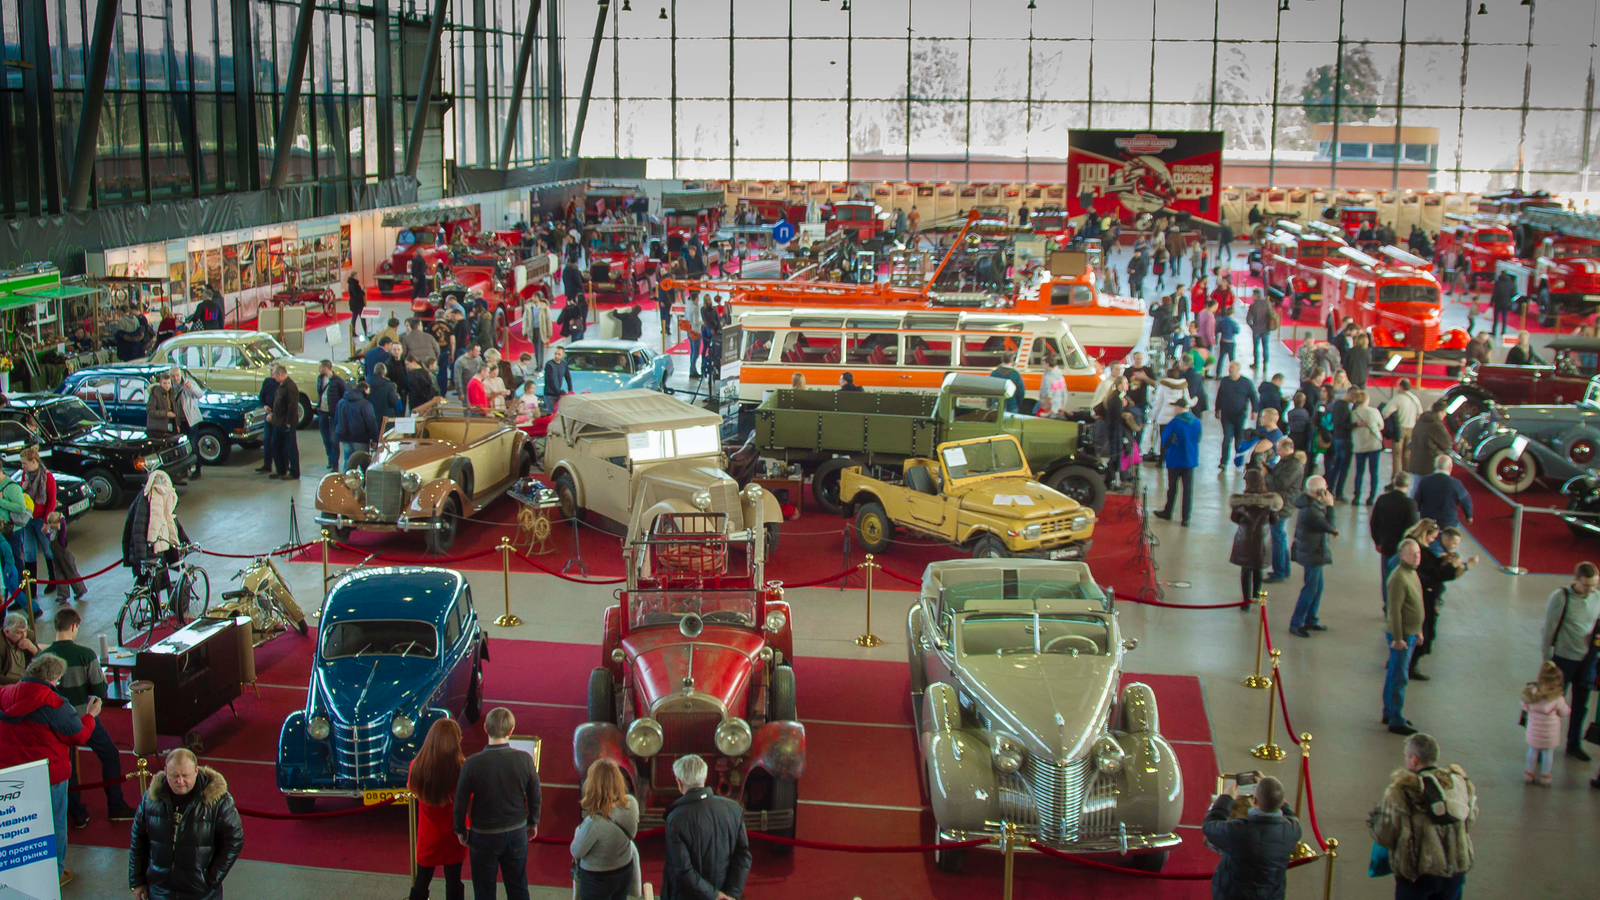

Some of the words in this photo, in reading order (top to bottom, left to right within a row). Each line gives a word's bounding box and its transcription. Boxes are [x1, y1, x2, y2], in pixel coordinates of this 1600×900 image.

[1078, 163, 1109, 182] 100
[1172, 164, 1214, 173] ПОЖАРНОЙ
[1173, 173, 1214, 184] ОХРАНЕ
[1076, 182, 1107, 198] ЛЕТ
[1174, 184, 1213, 199] СССР
[9, 840, 48, 856] проектов
[22, 849, 49, 863] рынке
